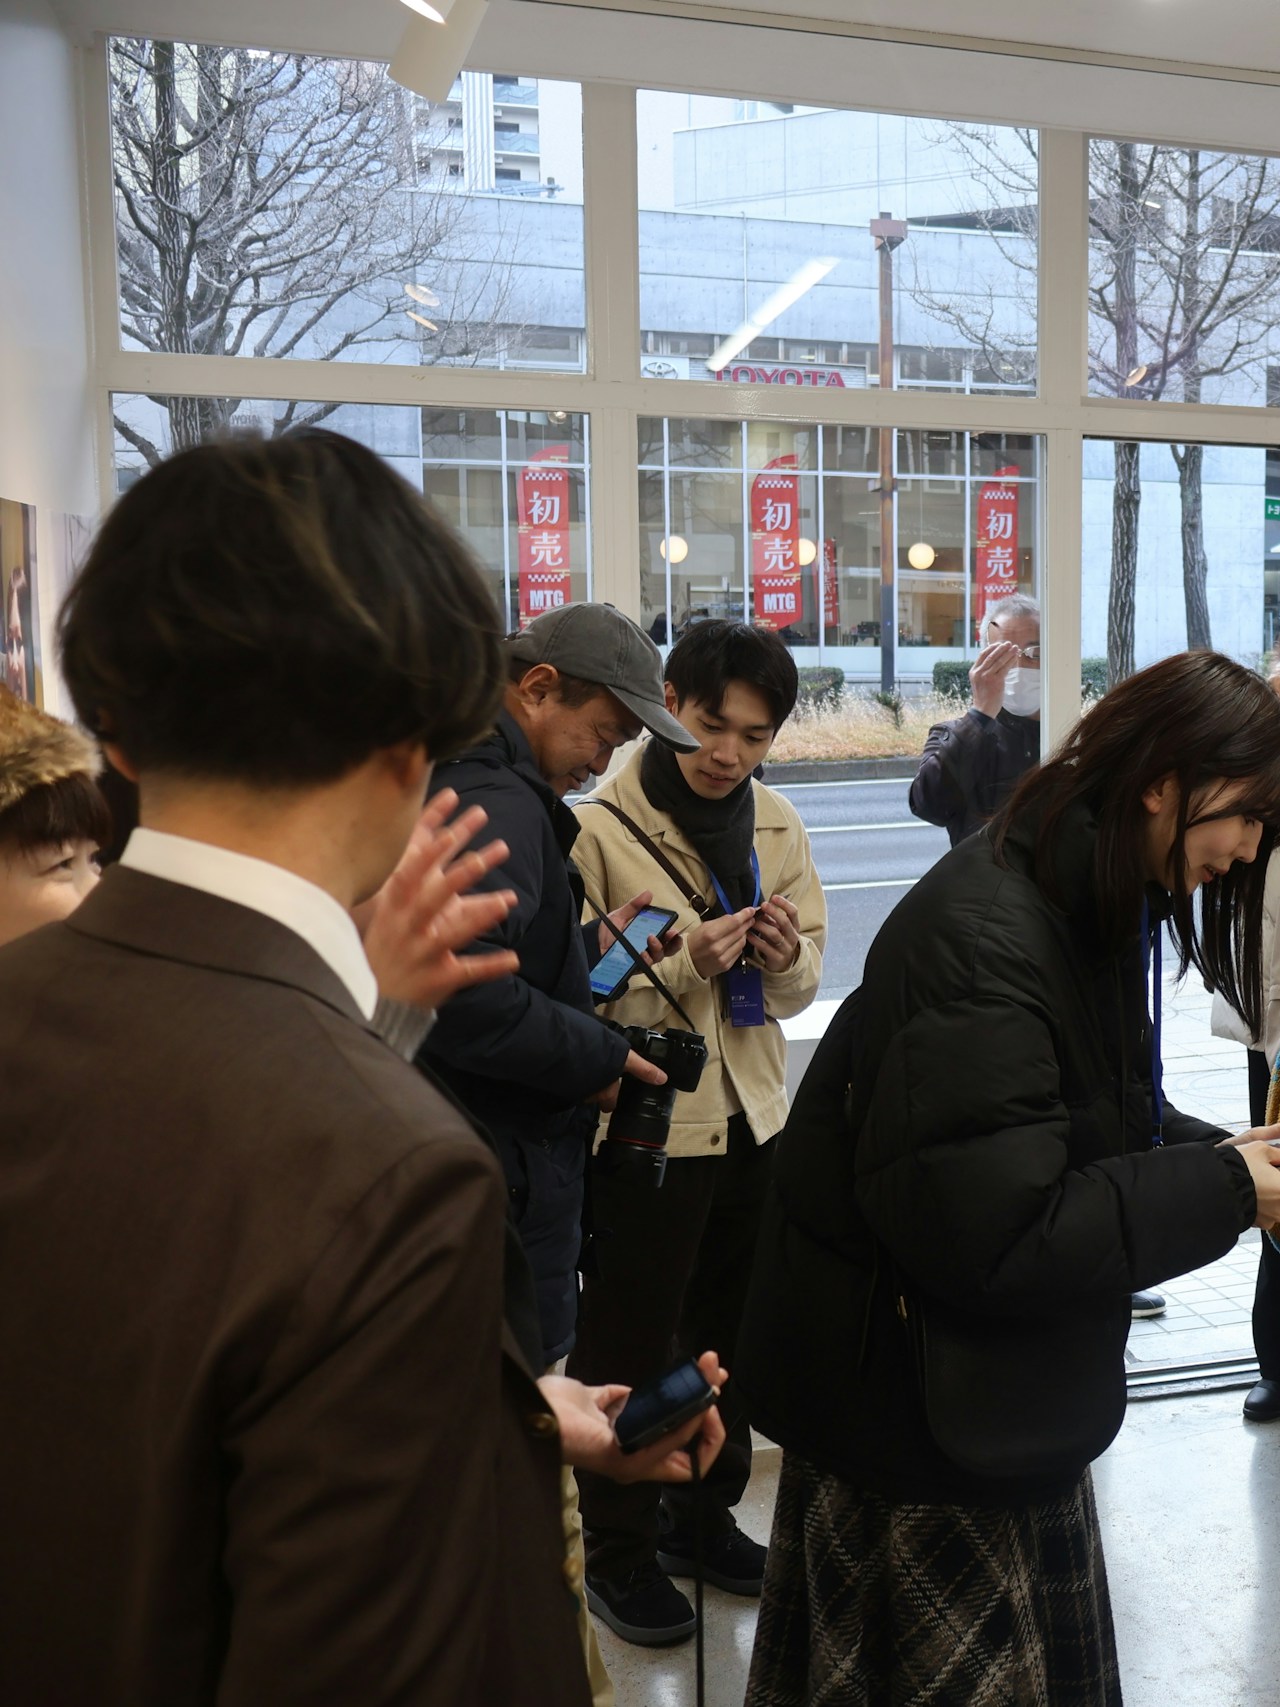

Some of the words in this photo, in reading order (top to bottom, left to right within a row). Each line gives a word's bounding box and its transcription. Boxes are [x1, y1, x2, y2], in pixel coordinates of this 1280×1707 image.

[527, 491, 563, 567] 初売
[760, 498, 795, 572] 初売
[985, 508, 1015, 579] 初売
[529, 589, 565, 607] MTG
[763, 593, 796, 610] MTG
